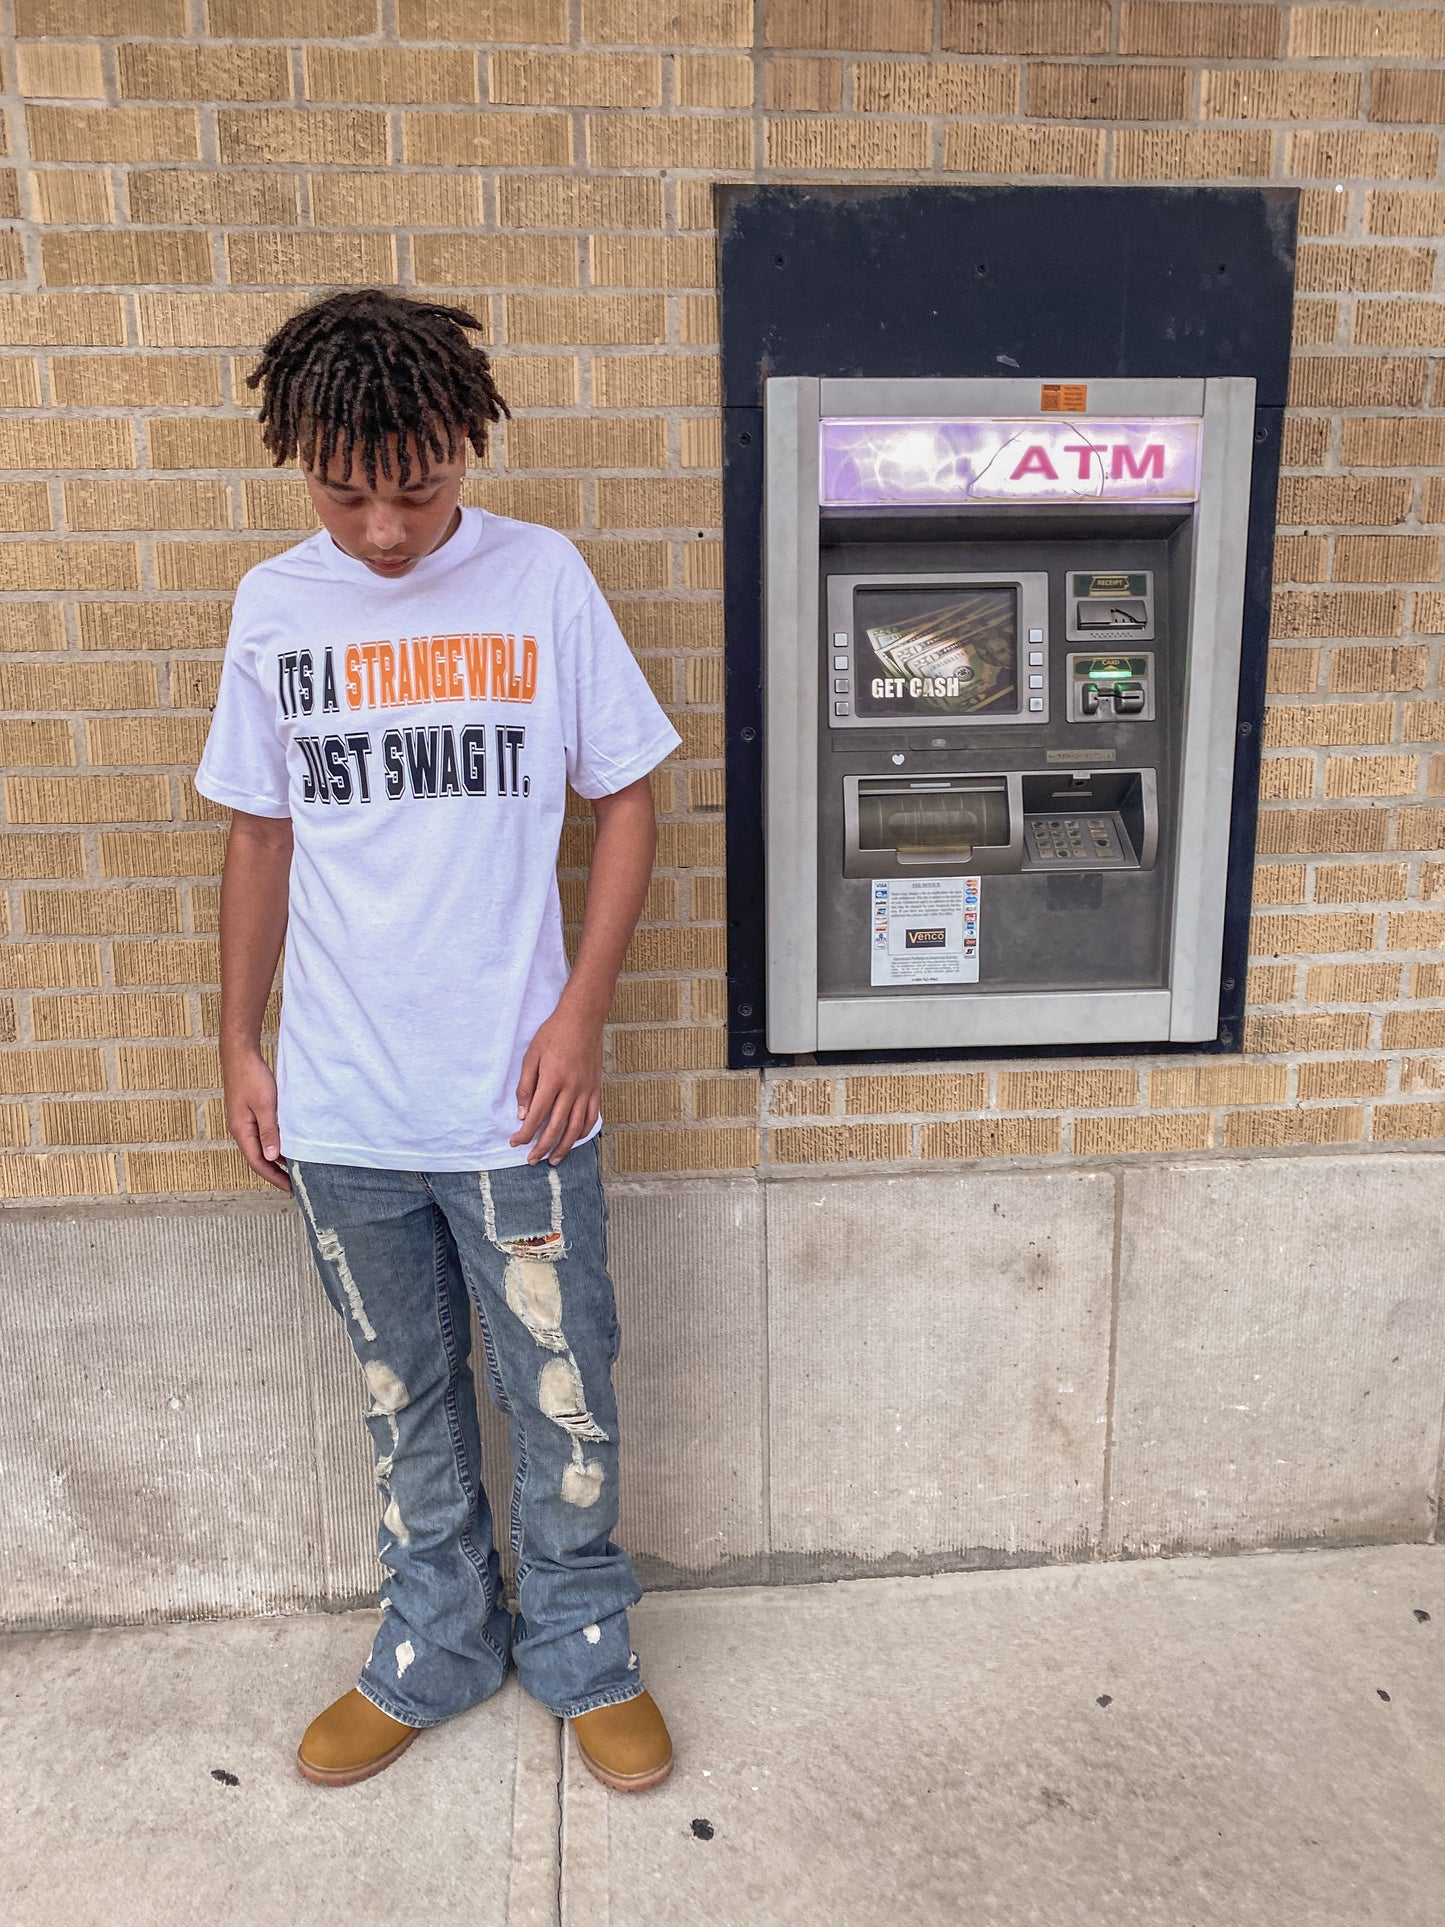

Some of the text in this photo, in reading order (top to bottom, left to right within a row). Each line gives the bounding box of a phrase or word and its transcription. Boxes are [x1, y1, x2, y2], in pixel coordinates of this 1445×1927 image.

[1009, 444, 1166, 480] ATM
[278, 633, 539, 720] ITS A STRANGEWRLD
[871, 677, 960, 698] GET CASH
[294, 724, 531, 805] JUST SWAG IT.
[909, 931, 945, 944] Venco
